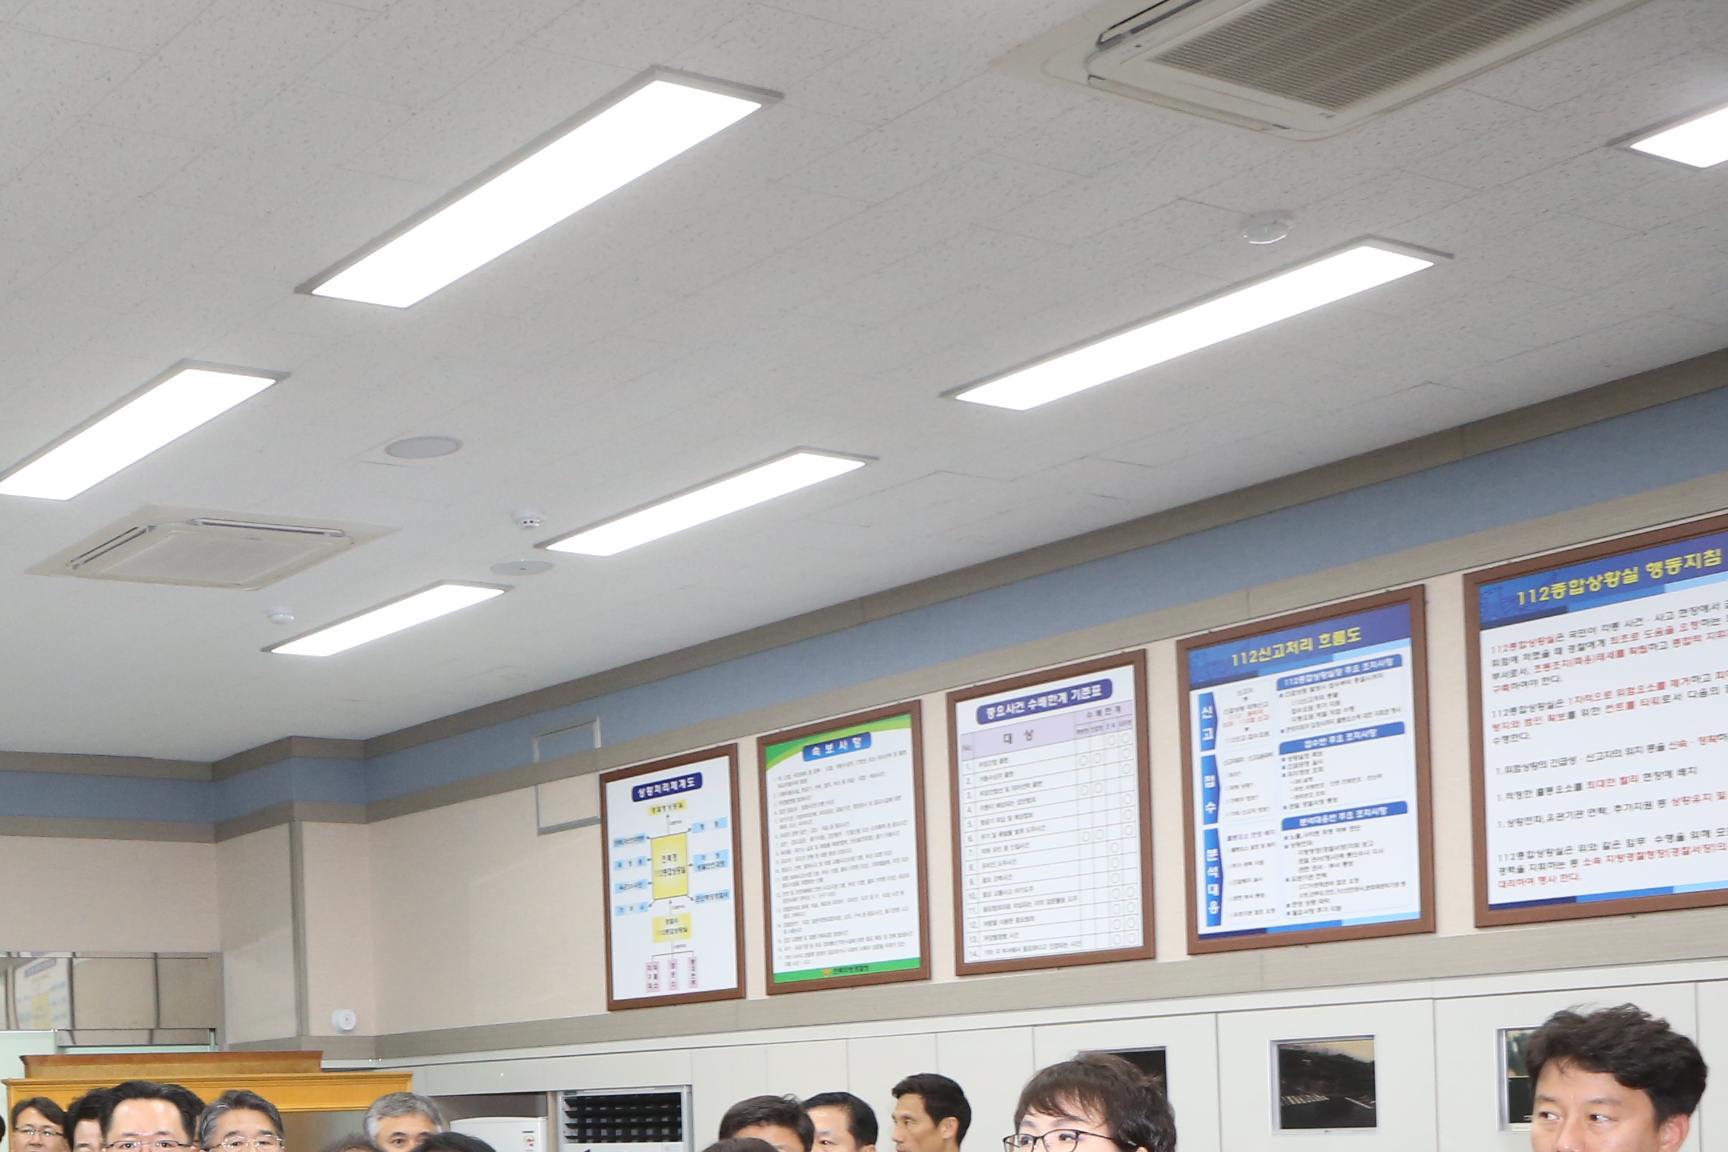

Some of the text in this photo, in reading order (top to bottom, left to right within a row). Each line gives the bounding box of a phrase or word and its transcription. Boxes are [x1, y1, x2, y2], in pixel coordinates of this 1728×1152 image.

[1516, 548, 1722, 606] 112종합상황실 행동지침
[1231, 626, 1362, 667] 112신고처리 흐름도
[986, 684, 1101, 719] 중요사건 수배한계 기준표
